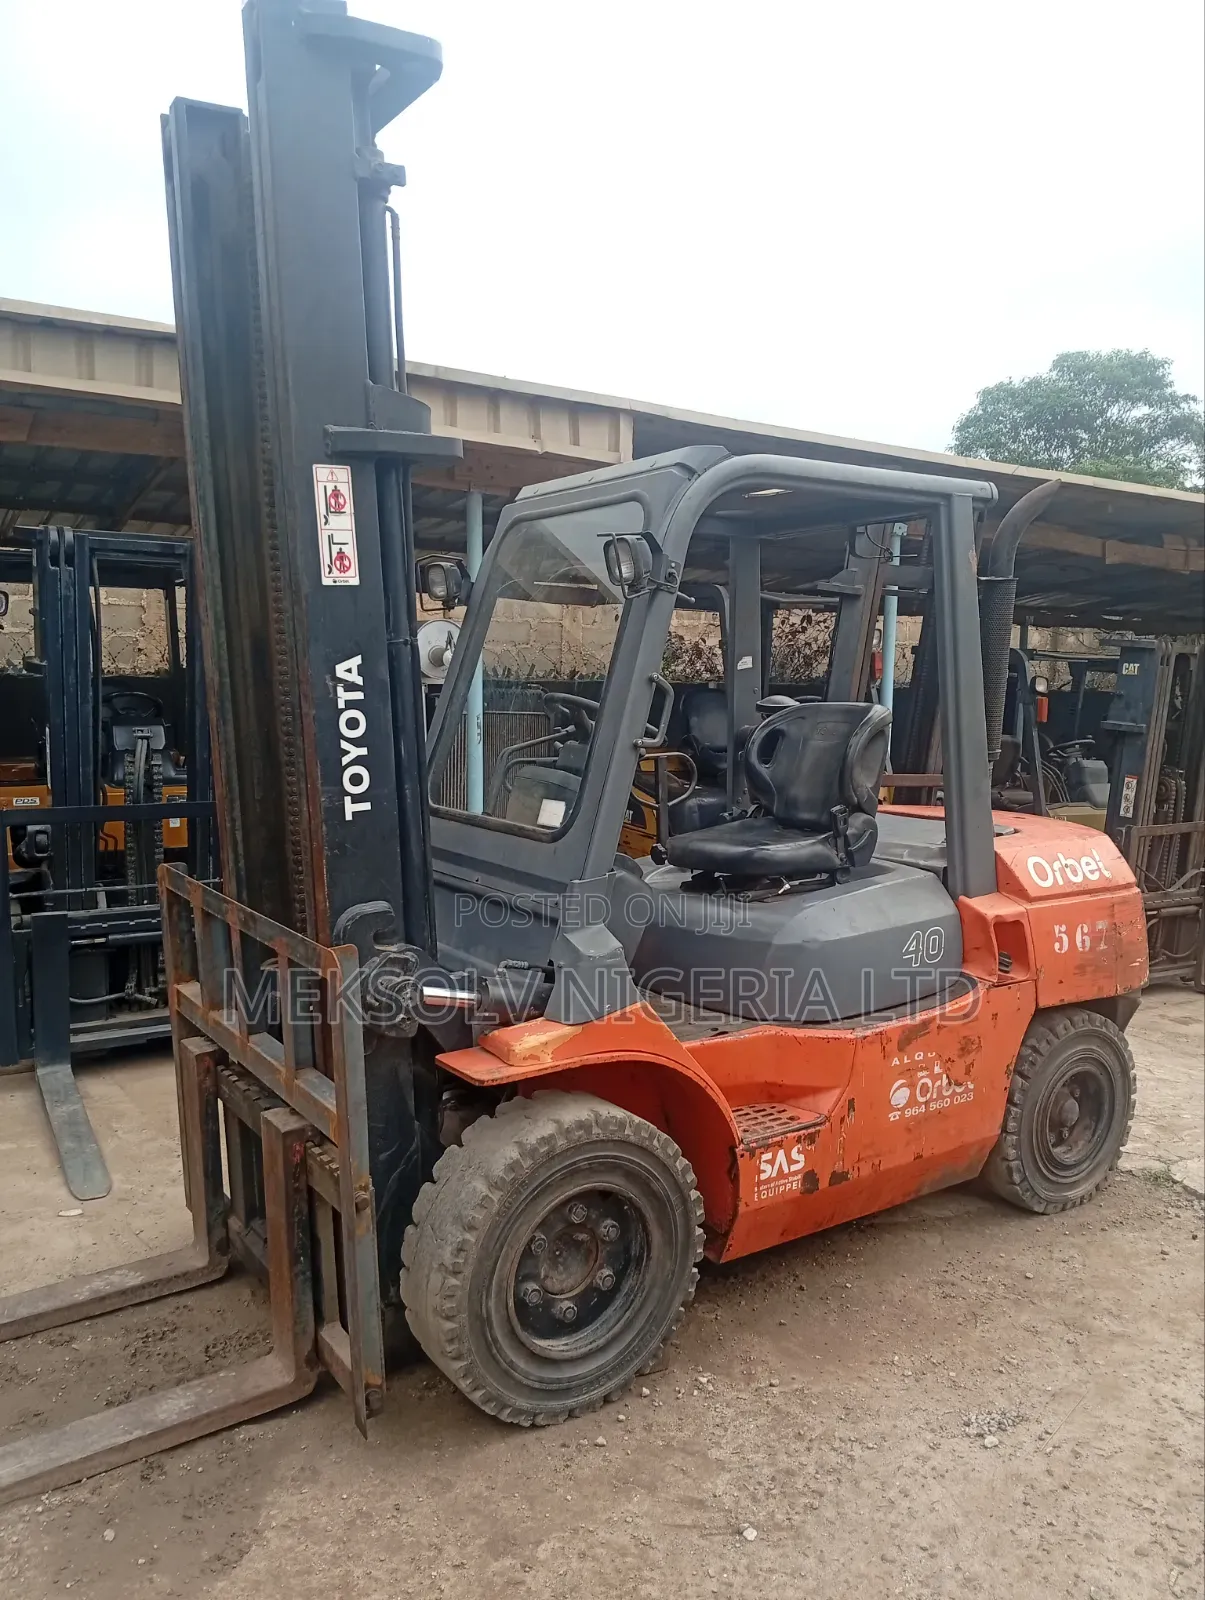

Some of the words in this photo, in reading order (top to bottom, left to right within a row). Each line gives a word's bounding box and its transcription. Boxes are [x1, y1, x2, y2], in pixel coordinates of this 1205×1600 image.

[1122, 662, 1140, 676] CAT
[334, 654, 372, 821] TOYOTA
[902, 926, 945, 968] 40
[904, 1104, 926, 1118] 964
[929, 1097, 951, 1111] 560
[953, 1091, 974, 1105] 023
[759, 1143, 806, 1181] SAS
